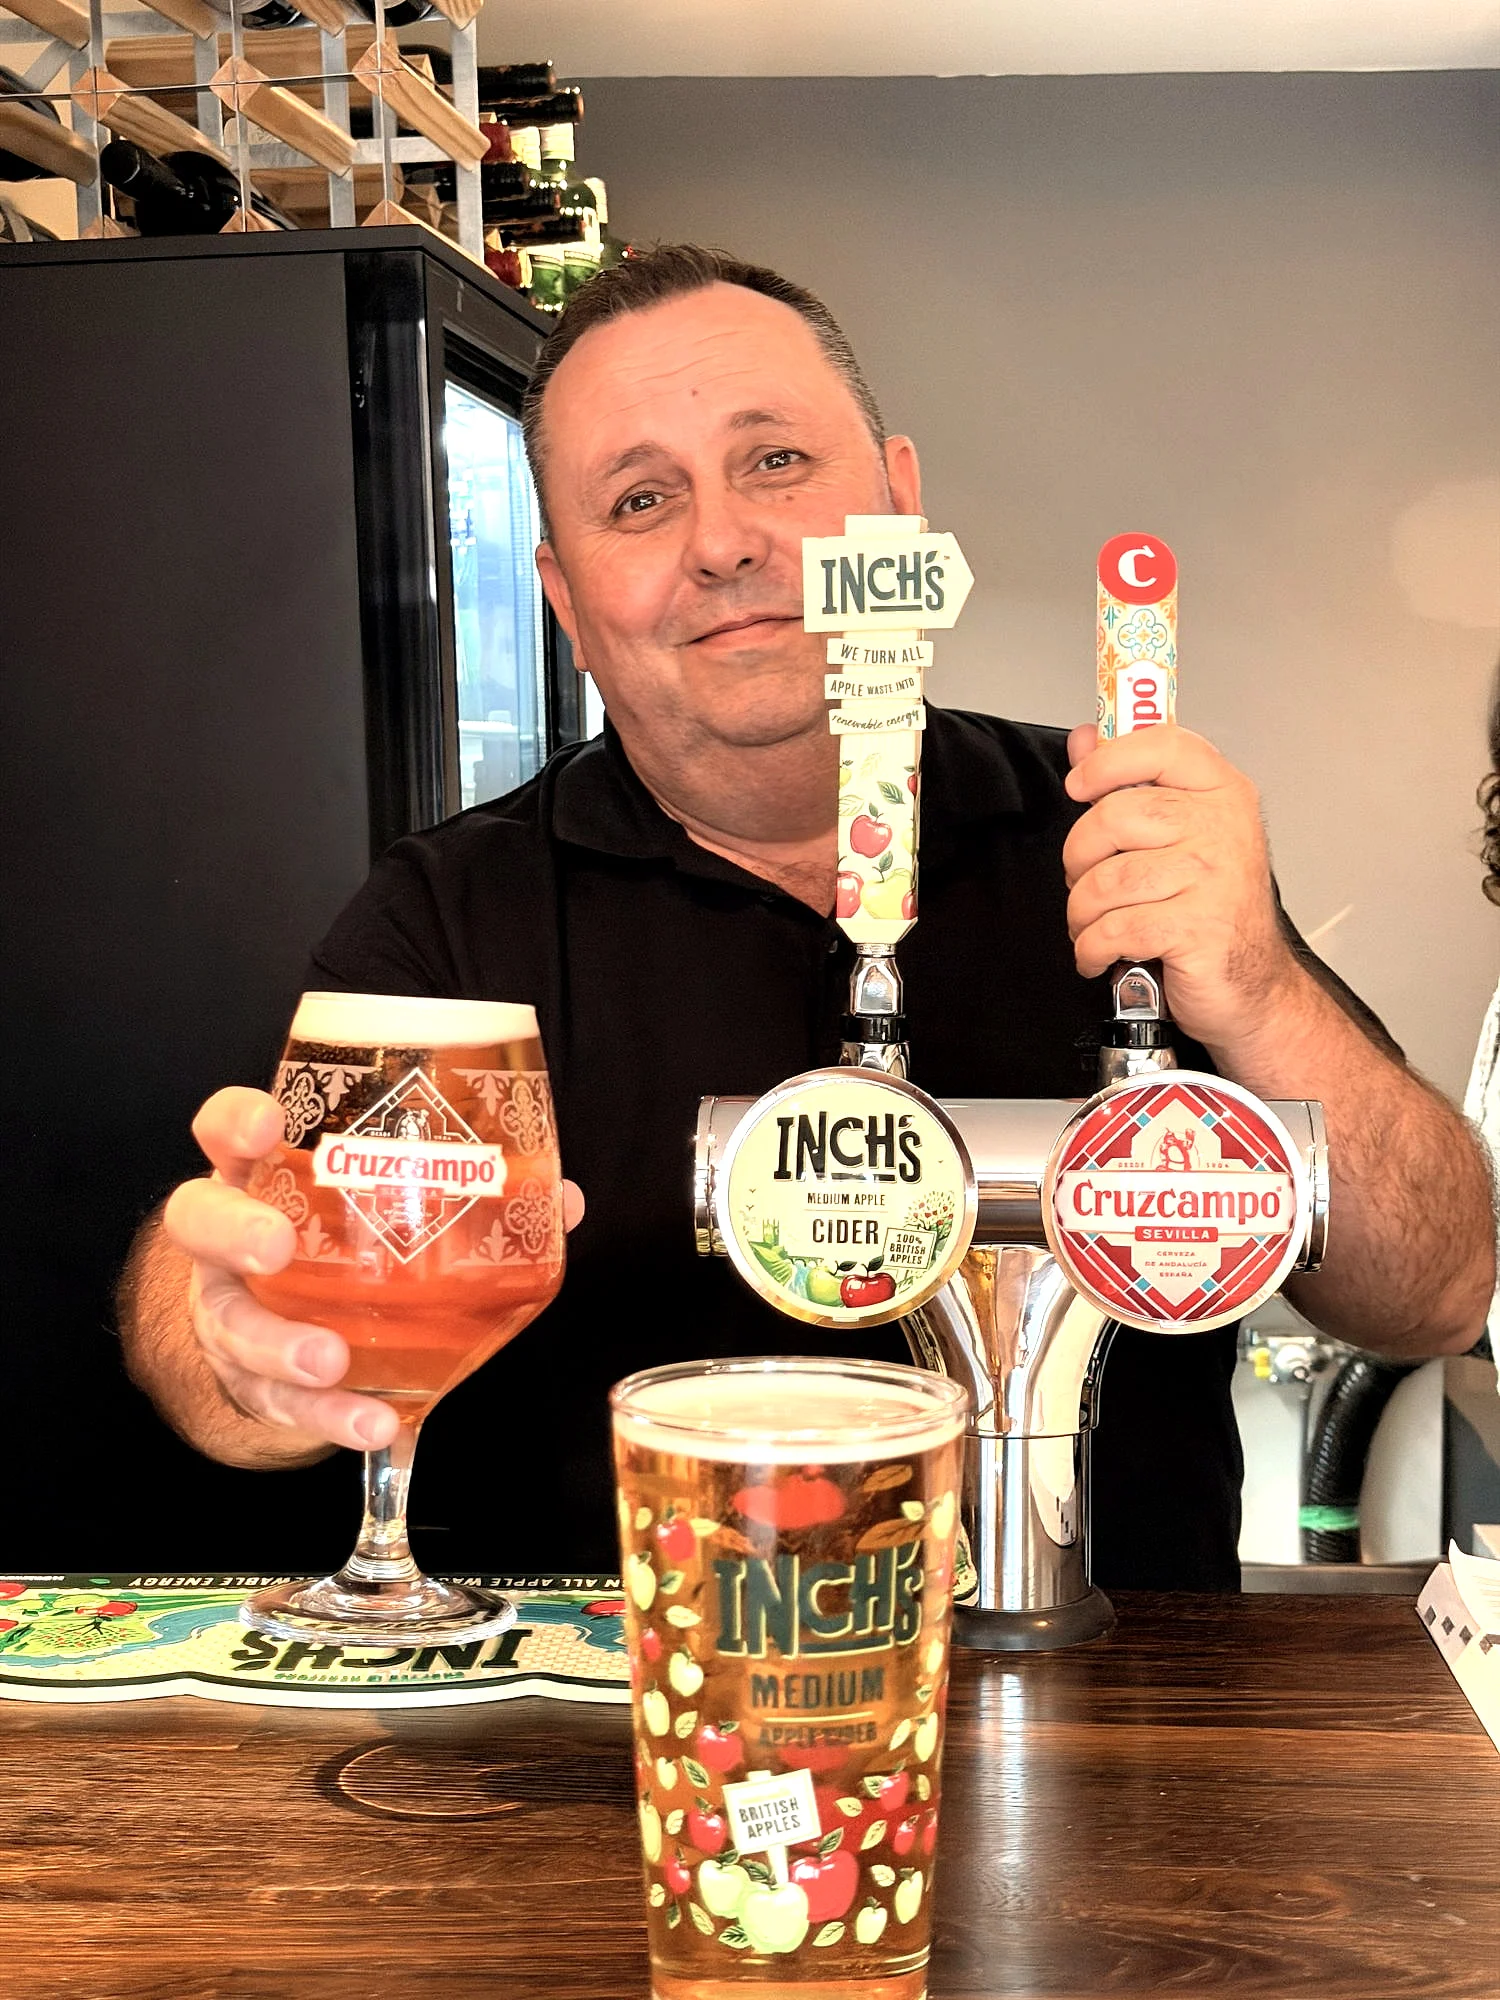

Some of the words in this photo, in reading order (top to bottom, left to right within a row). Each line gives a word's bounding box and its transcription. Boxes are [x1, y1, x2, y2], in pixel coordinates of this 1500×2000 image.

[1118, 545, 1157, 588] C
[840, 643, 858, 661] WE
[864, 648, 897, 664] TURN
[902, 645, 925, 662] ALL
[830, 679, 863, 697] APPLE
[867, 683, 893, 695] WASTE
[896, 677, 915, 691] INTO
[832, 713, 883, 730] renewable
[886, 709, 920, 728] energy
[326, 1143, 497, 1188] Cruzcampo
[807, 1192, 850, 1206] MEDIUM
[854, 1193, 886, 1207] APPLE
[1073, 1179, 1281, 1225] Cruzcampo
[812, 1218, 879, 1245] CIDER
[896, 1233, 922, 1244] 100%
[1142, 1228, 1210, 1240] SEVILLA
[889, 1243, 926, 1255] BRITISH
[889, 1253, 923, 1265] APPLES
[128, 1576, 214, 1587] ENERGY
[490, 1577, 554, 1587] APPLE
[561, 1578, 598, 1588] ALL
[751, 1667, 886, 1710] MEDIUM
[738, 1796, 800, 1824] BRITISH
[747, 1814, 802, 1840] APPLES
